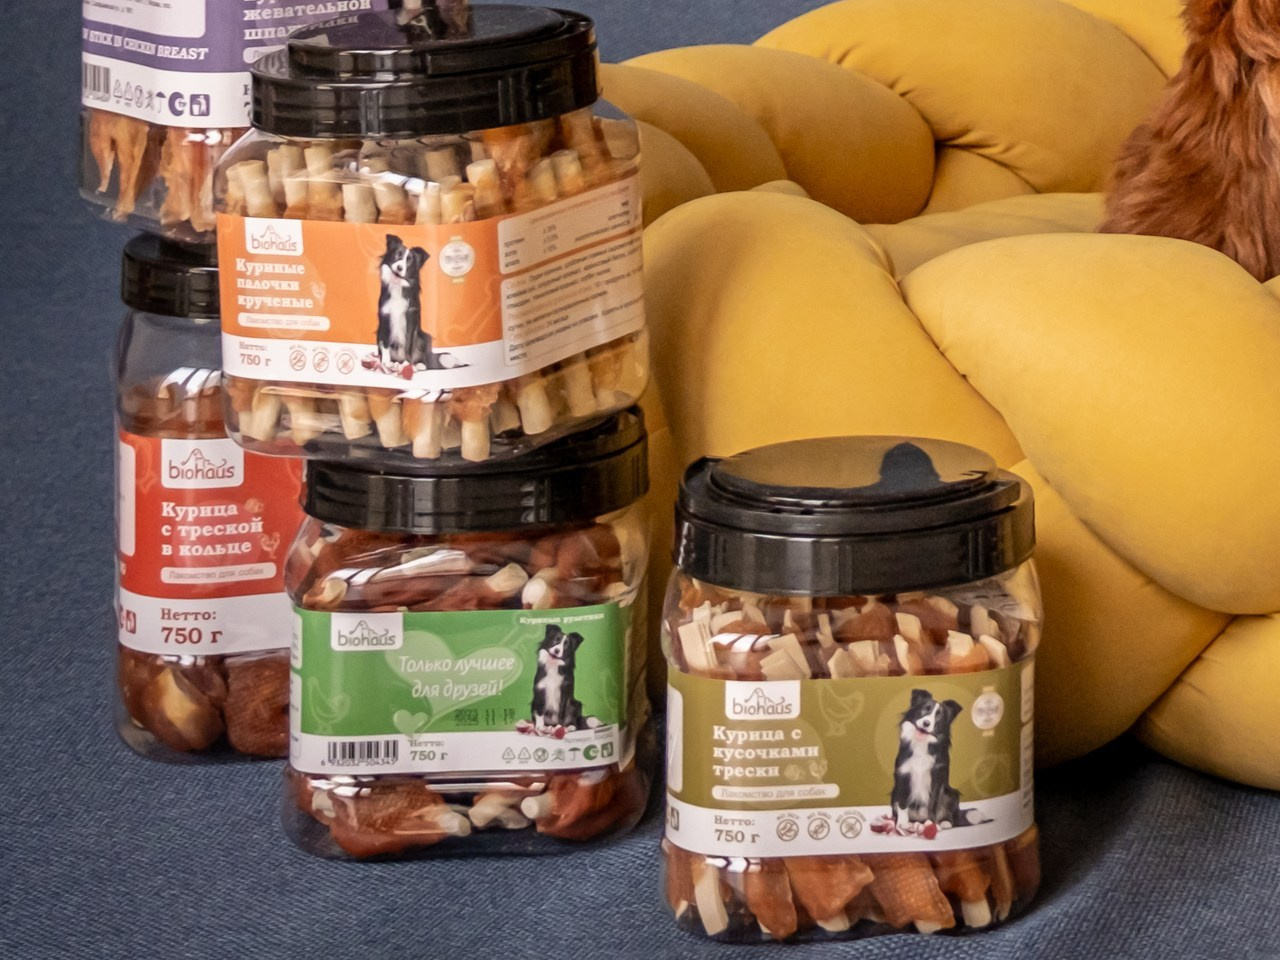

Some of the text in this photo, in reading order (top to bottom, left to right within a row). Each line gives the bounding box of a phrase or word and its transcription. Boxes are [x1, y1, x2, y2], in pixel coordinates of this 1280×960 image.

[157, 44, 209, 60] BREAST
[251, 233, 297, 251] biohaus
[236, 258, 305, 276] Куриные
[237, 278, 300, 291] палочки
[237, 295, 314, 310] крученые
[240, 353, 261, 366] 750
[169, 459, 234, 479] biohaus
[162, 501, 238, 520] Курица
[161, 517, 263, 540] с треской
[161, 541, 252, 556] в кольце
[161, 607, 216, 621] Нетто:
[161, 627, 222, 644] 750 г
[338, 631, 395, 647] biohaus
[399, 656, 515, 675] Только лучшее
[411, 680, 504, 700] для друзей!
[732, 697, 792, 716] biohaus
[713, 725, 802, 744] Курица с
[410, 750, 448, 761] 750 г
[712, 746, 819, 761] кусочками
[712, 765, 779, 780] трески
[714, 815, 755, 826] Нетто:
[714, 828, 761, 843] 750 г
